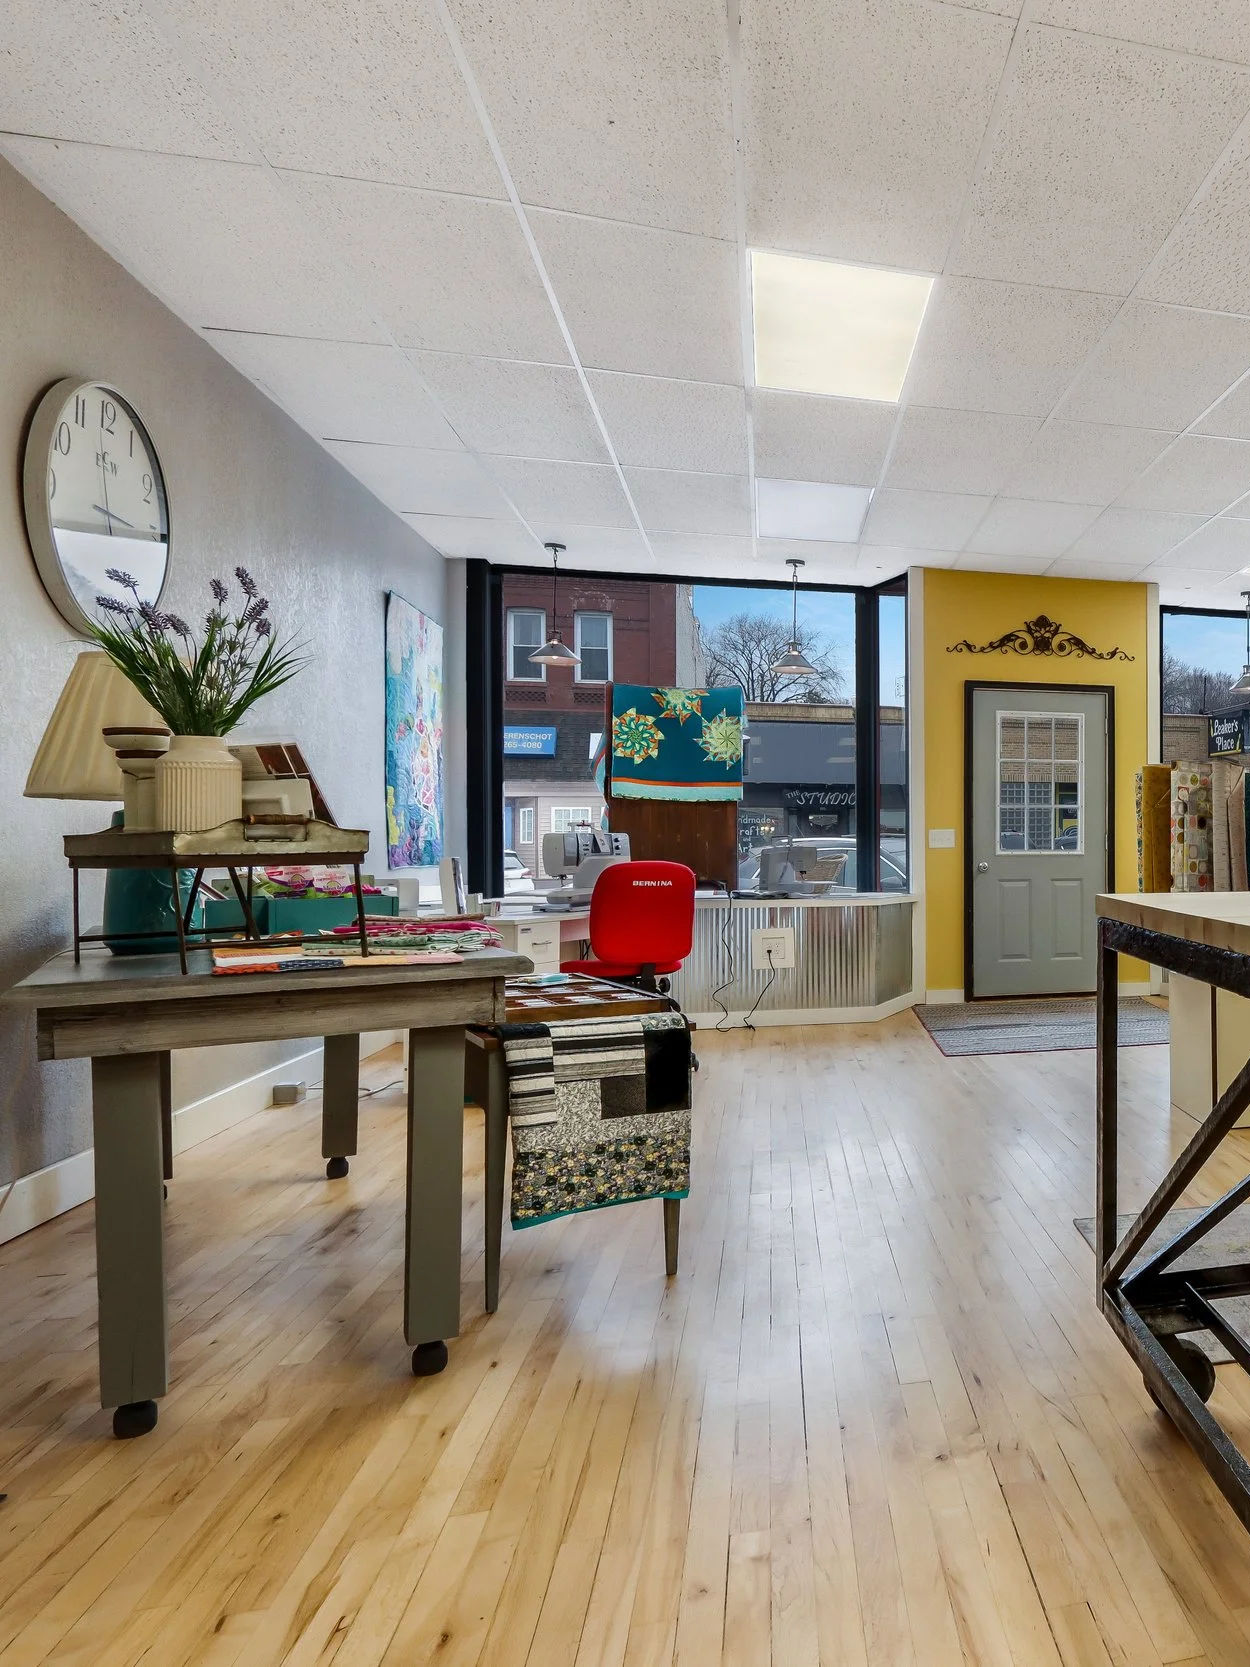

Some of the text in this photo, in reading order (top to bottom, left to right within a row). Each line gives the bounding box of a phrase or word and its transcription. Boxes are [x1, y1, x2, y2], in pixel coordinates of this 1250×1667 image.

[101, 400, 117, 435] 12
[142, 473, 153, 505] 2
[503, 732, 552, 740] ERENSCHOT
[503, 741, 543, 749] 265-4080
[1215, 736, 1235, 751] Place
[785, 789, 801, 799] THE
